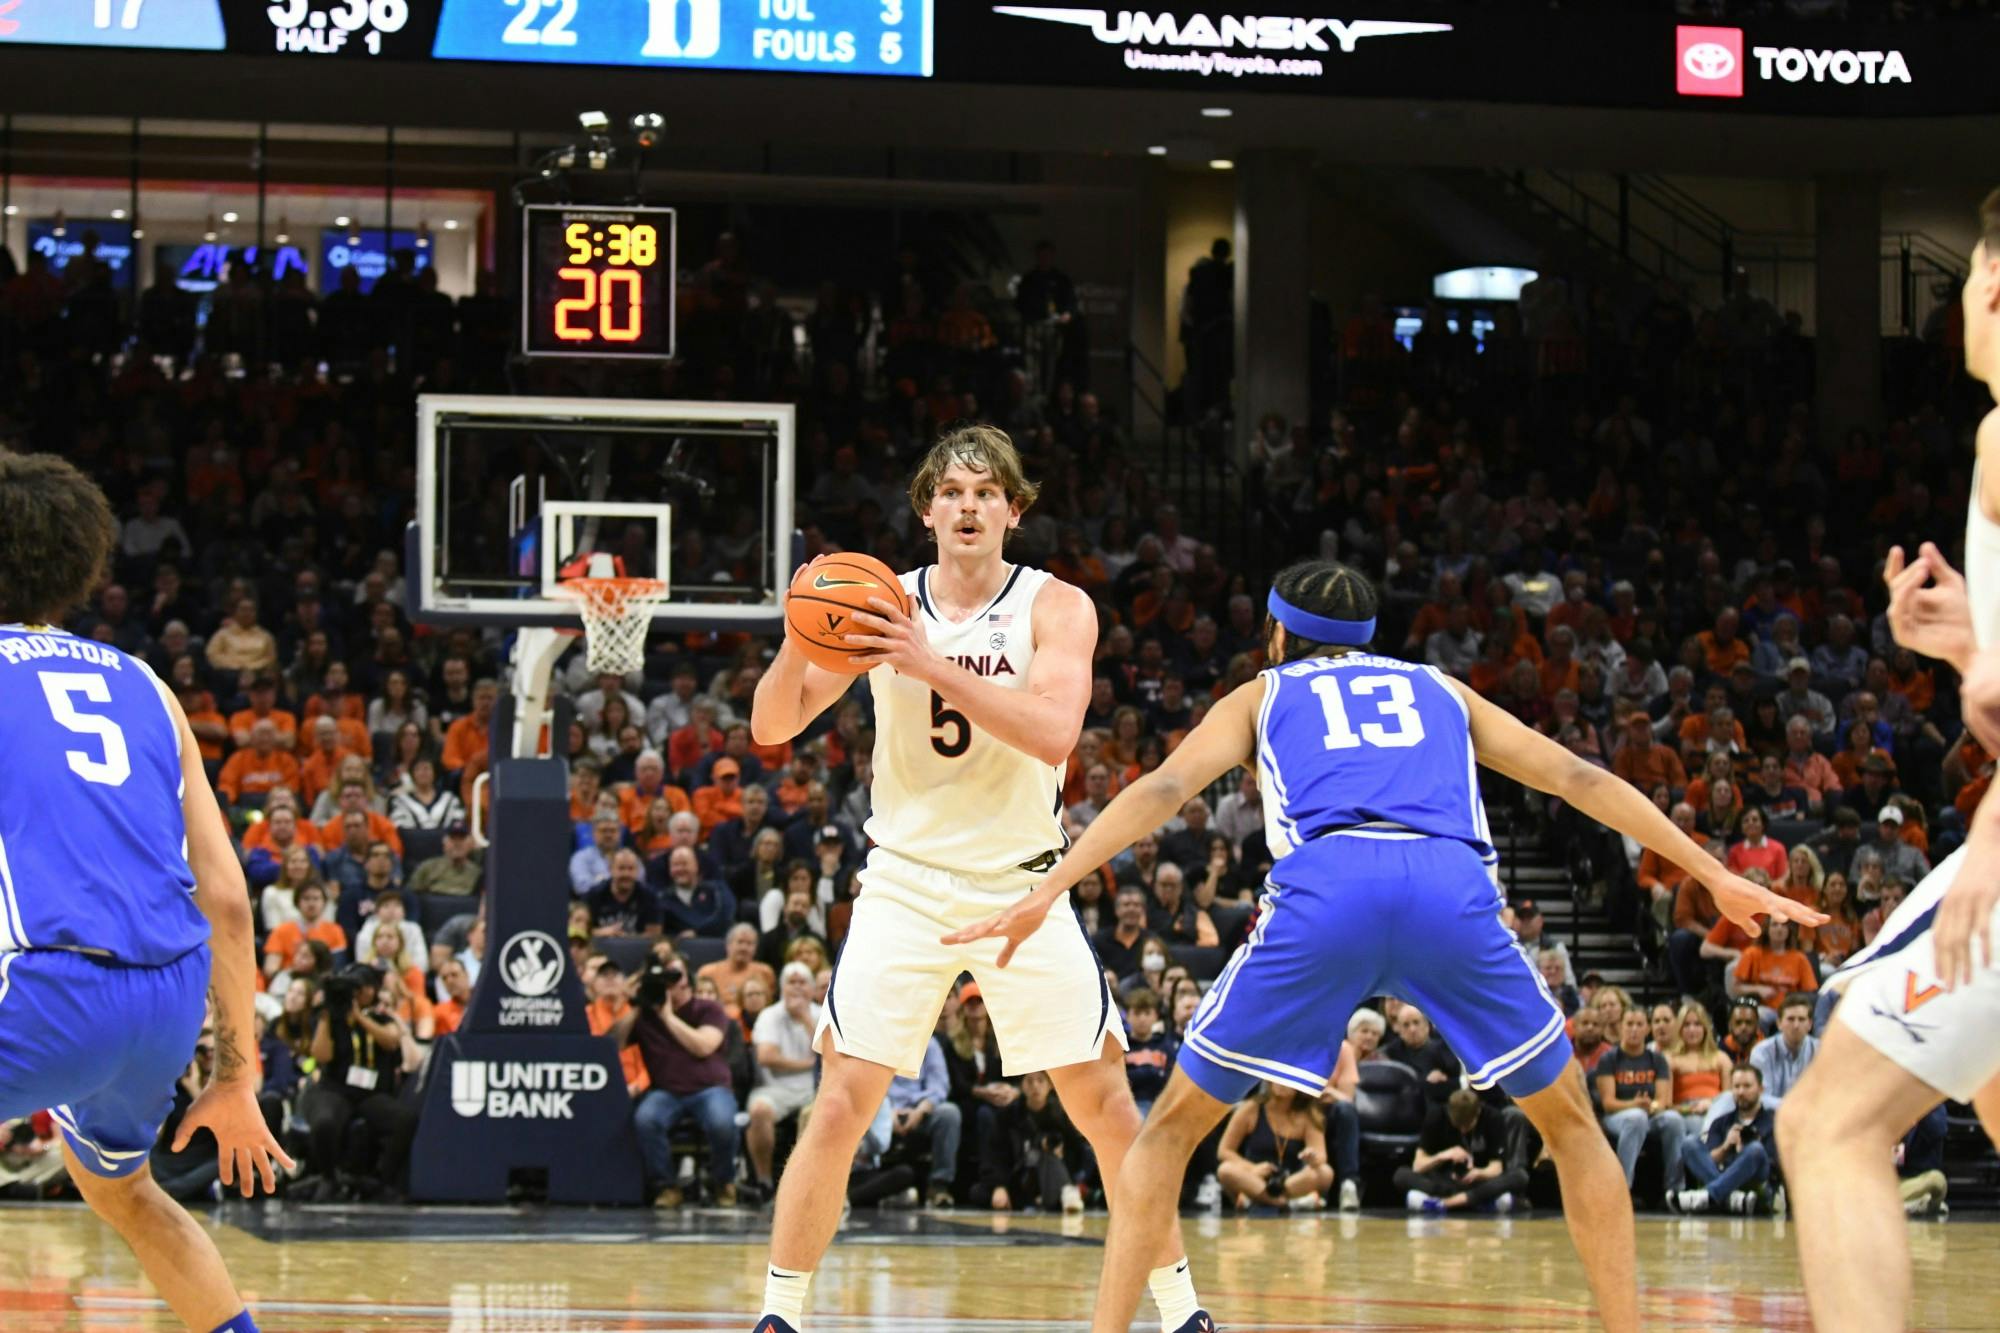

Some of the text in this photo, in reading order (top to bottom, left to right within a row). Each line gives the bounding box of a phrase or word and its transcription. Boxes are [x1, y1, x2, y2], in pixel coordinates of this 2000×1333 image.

[276, 27, 381, 55] HALF 1
[502, 0, 578, 46] 22
[1091, 10, 1360, 52] UMANSKY
[752, 28, 903, 65] FOULS 5
[1124, 48, 1323, 77] UmanskyToyota.com
[1753, 46, 1912, 84] TOYOTA
[566, 223, 657, 266] 5:38
[555, 268, 642, 341] 20
[0, 635, 122, 671] PROCTOR
[37, 671, 131, 786] 5
[930, 687, 972, 758] 5
[1309, 674, 1425, 750] 13
[498, 1011, 563, 1026] LOTTERY
[499, 997, 563, 1011] VIRGINIA
[488, 1062, 608, 1090] UNITED
[487, 1091, 574, 1119] BANK
